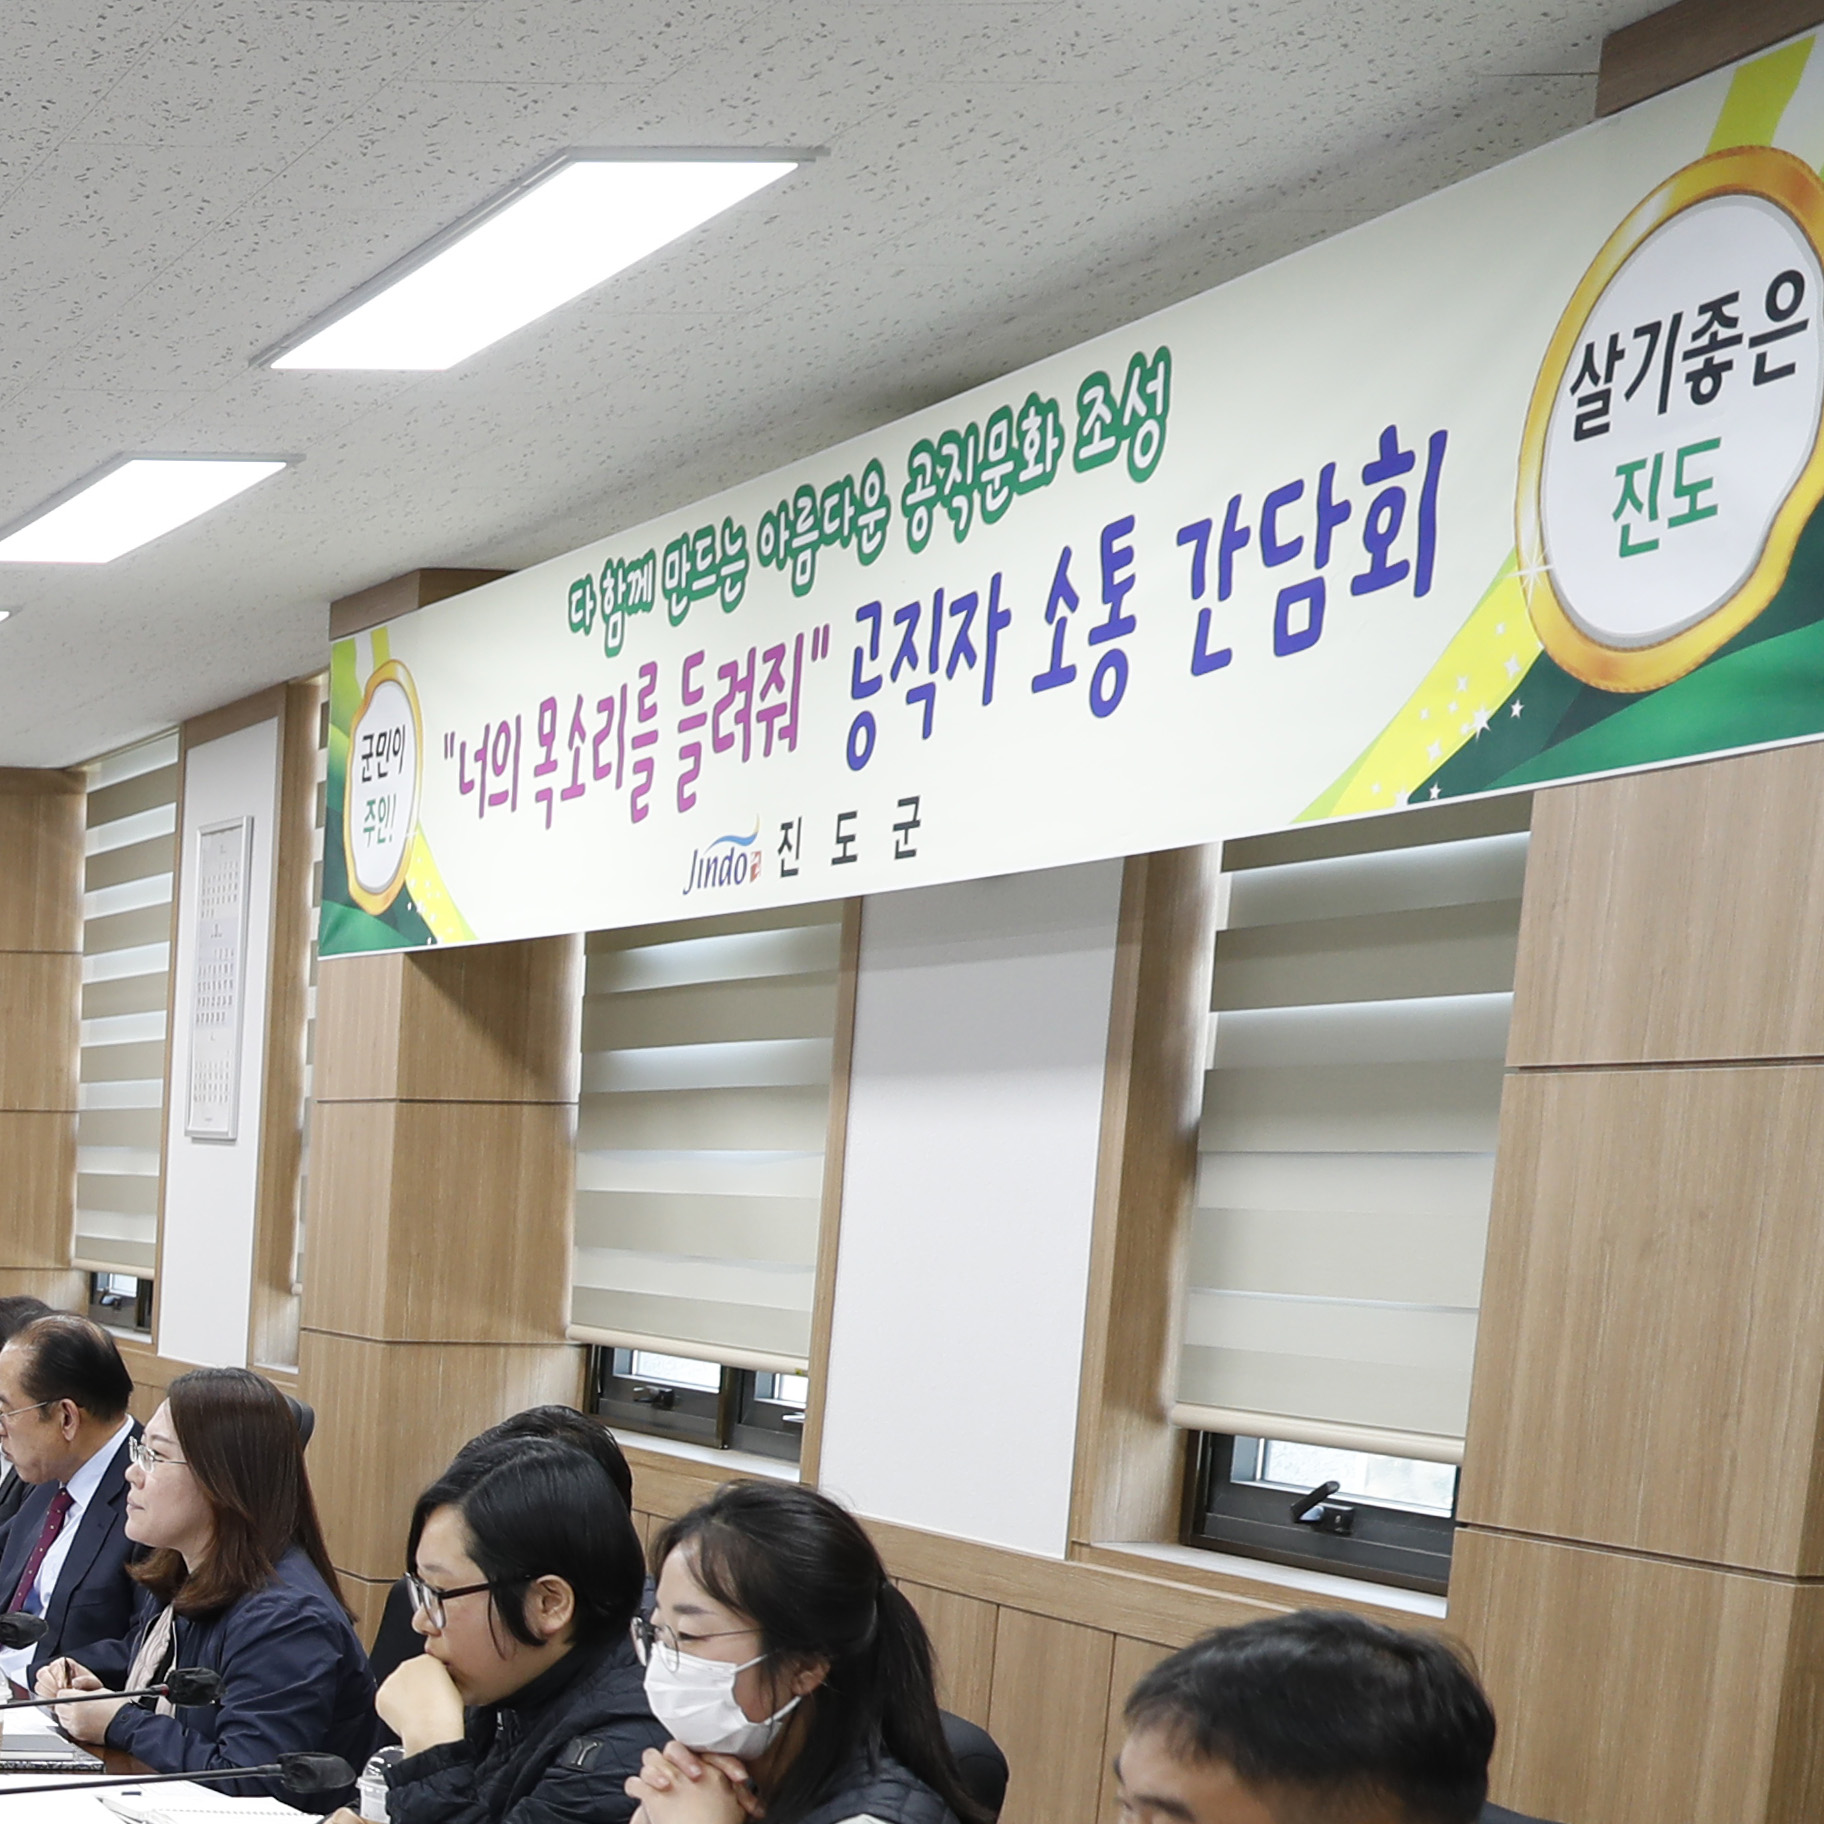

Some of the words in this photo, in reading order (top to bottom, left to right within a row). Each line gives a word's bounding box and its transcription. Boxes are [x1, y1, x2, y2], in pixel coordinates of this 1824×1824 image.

[1570, 269, 1810, 442] 살기좋은
[662, 516, 750, 627] 만드는
[757, 457, 890, 599] 아름다운
[904, 391, 1064, 553] 공직문화
[1073, 345, 1172, 483] 조성
[1612, 436, 1722, 558] 진도
[444, 714, 521, 819] "너의
[534, 661, 659, 830] 목소리를
[677, 623, 830, 813] 들려줘"
[846, 572, 1011, 772] 공직자
[1031, 514, 1137, 718] 소통
[1176, 423, 1448, 677] 간담회
[361, 724, 406, 783] 군민이
[362, 793, 397, 848] 주인!
[683, 845, 749, 896] Jindo
